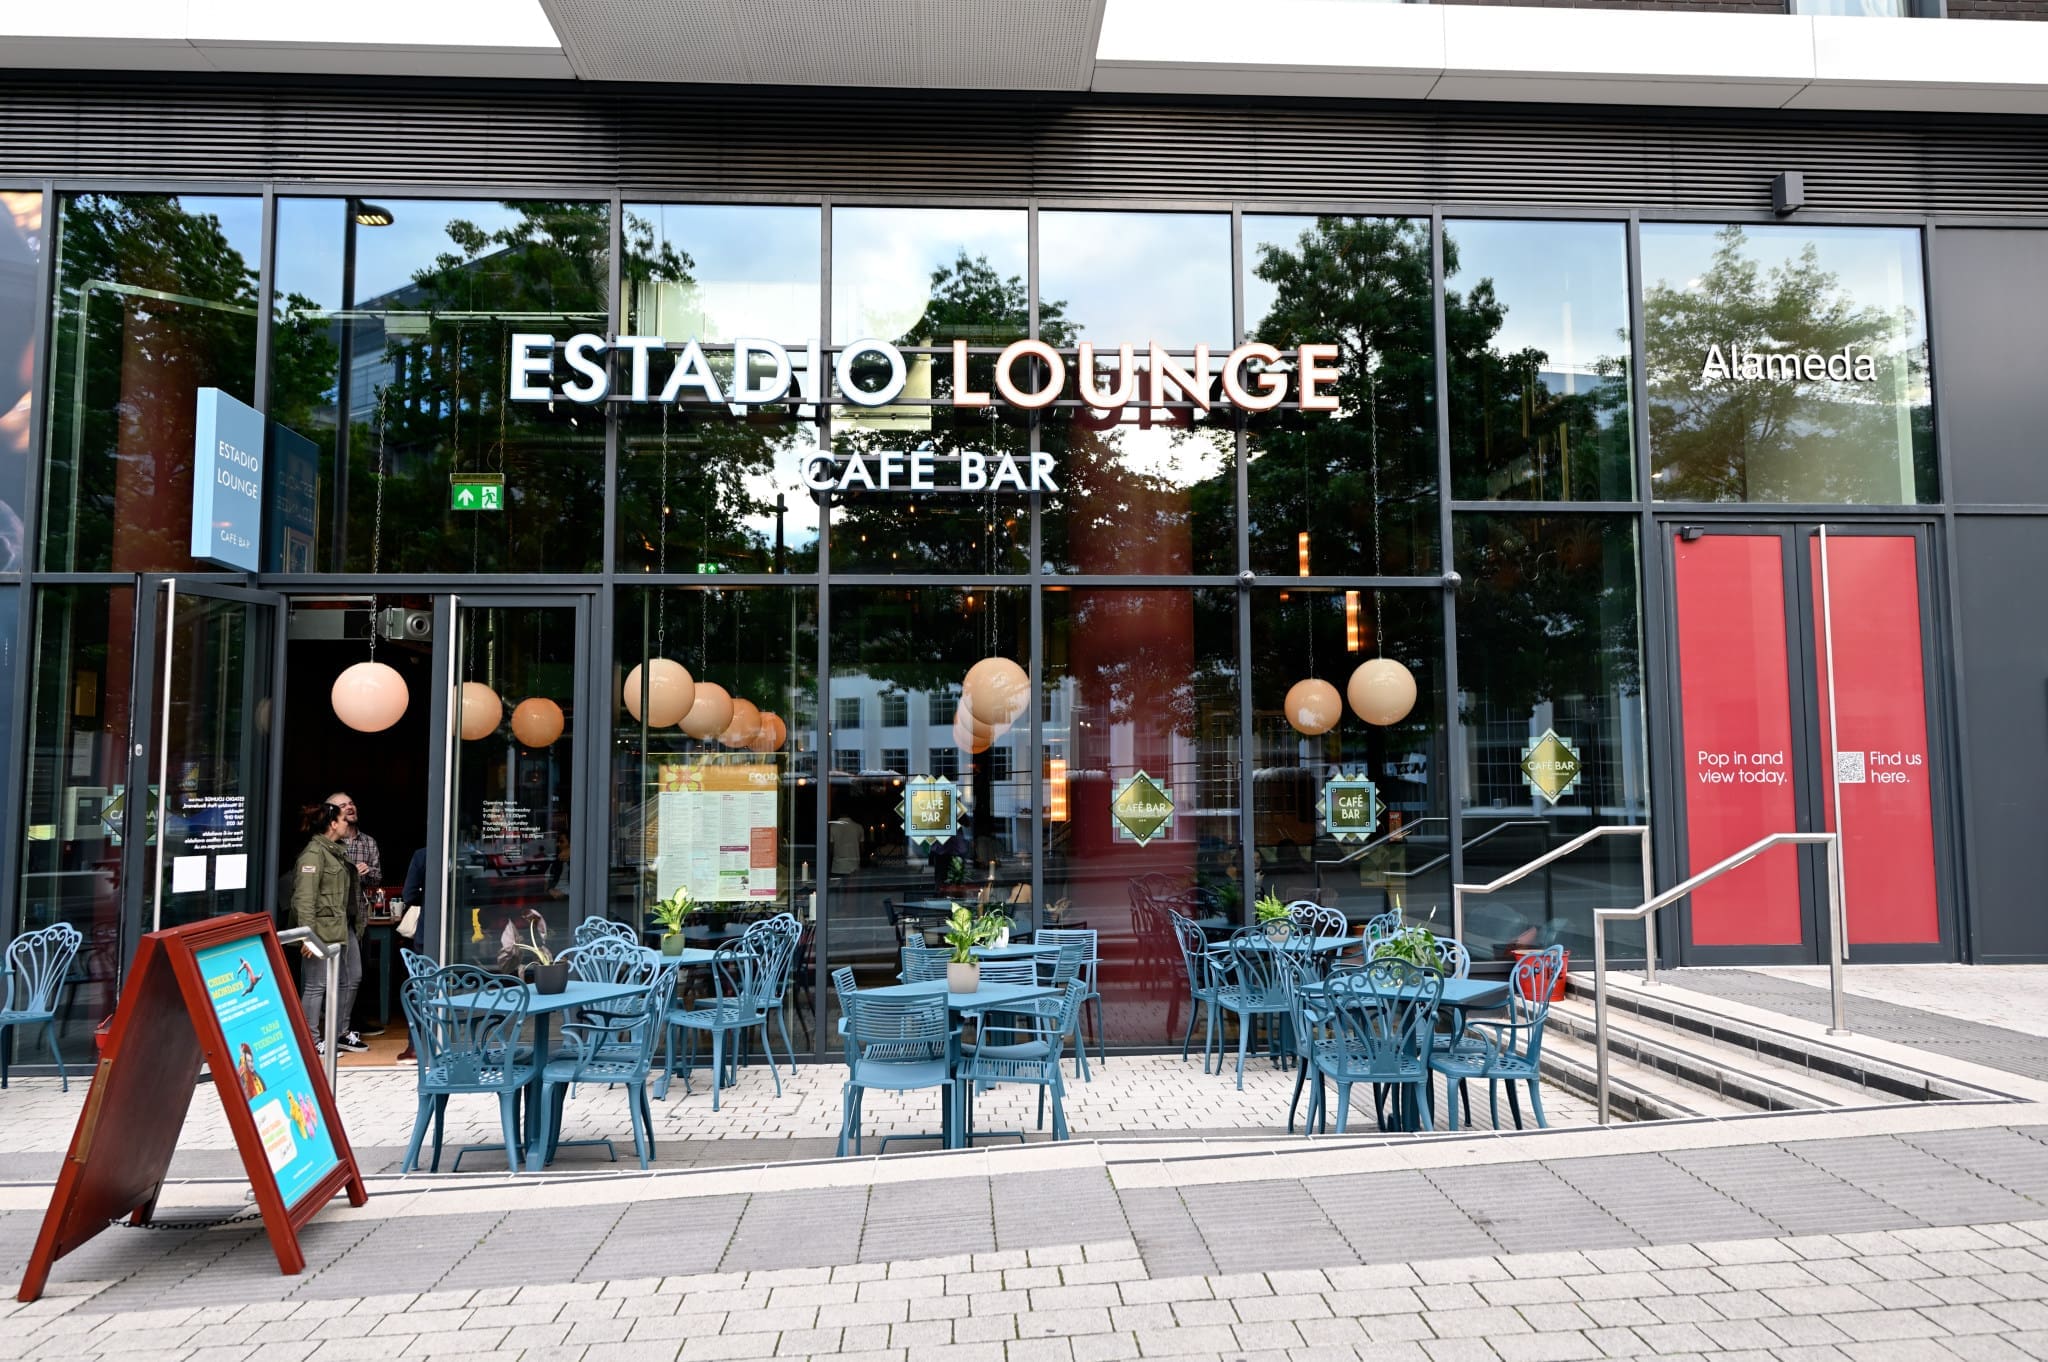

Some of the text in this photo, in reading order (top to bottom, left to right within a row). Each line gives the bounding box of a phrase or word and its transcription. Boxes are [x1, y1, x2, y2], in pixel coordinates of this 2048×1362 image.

[1702, 344, 1878, 381] Alameda
[510, 333, 1340, 412] ESTADIO LOUNGE
[219, 440, 258, 472] ESTADIO
[802, 441, 1060, 492] CAFÉ BAR
[217, 467, 258, 500] LOUNGE
[1555, 761, 1574, 770] BAR
[1698, 751, 1783, 767] Pop in and
[1870, 751, 1922, 765] Find us
[1698, 769, 1788, 785] view today.
[1871, 769, 1910, 784] here.
[1118, 801, 1166, 812] CAFÉ BAR
[1338, 794, 1364, 808] CAFÉ
[921, 811, 941, 823] BAR
[1341, 809, 1360, 819] BAR
